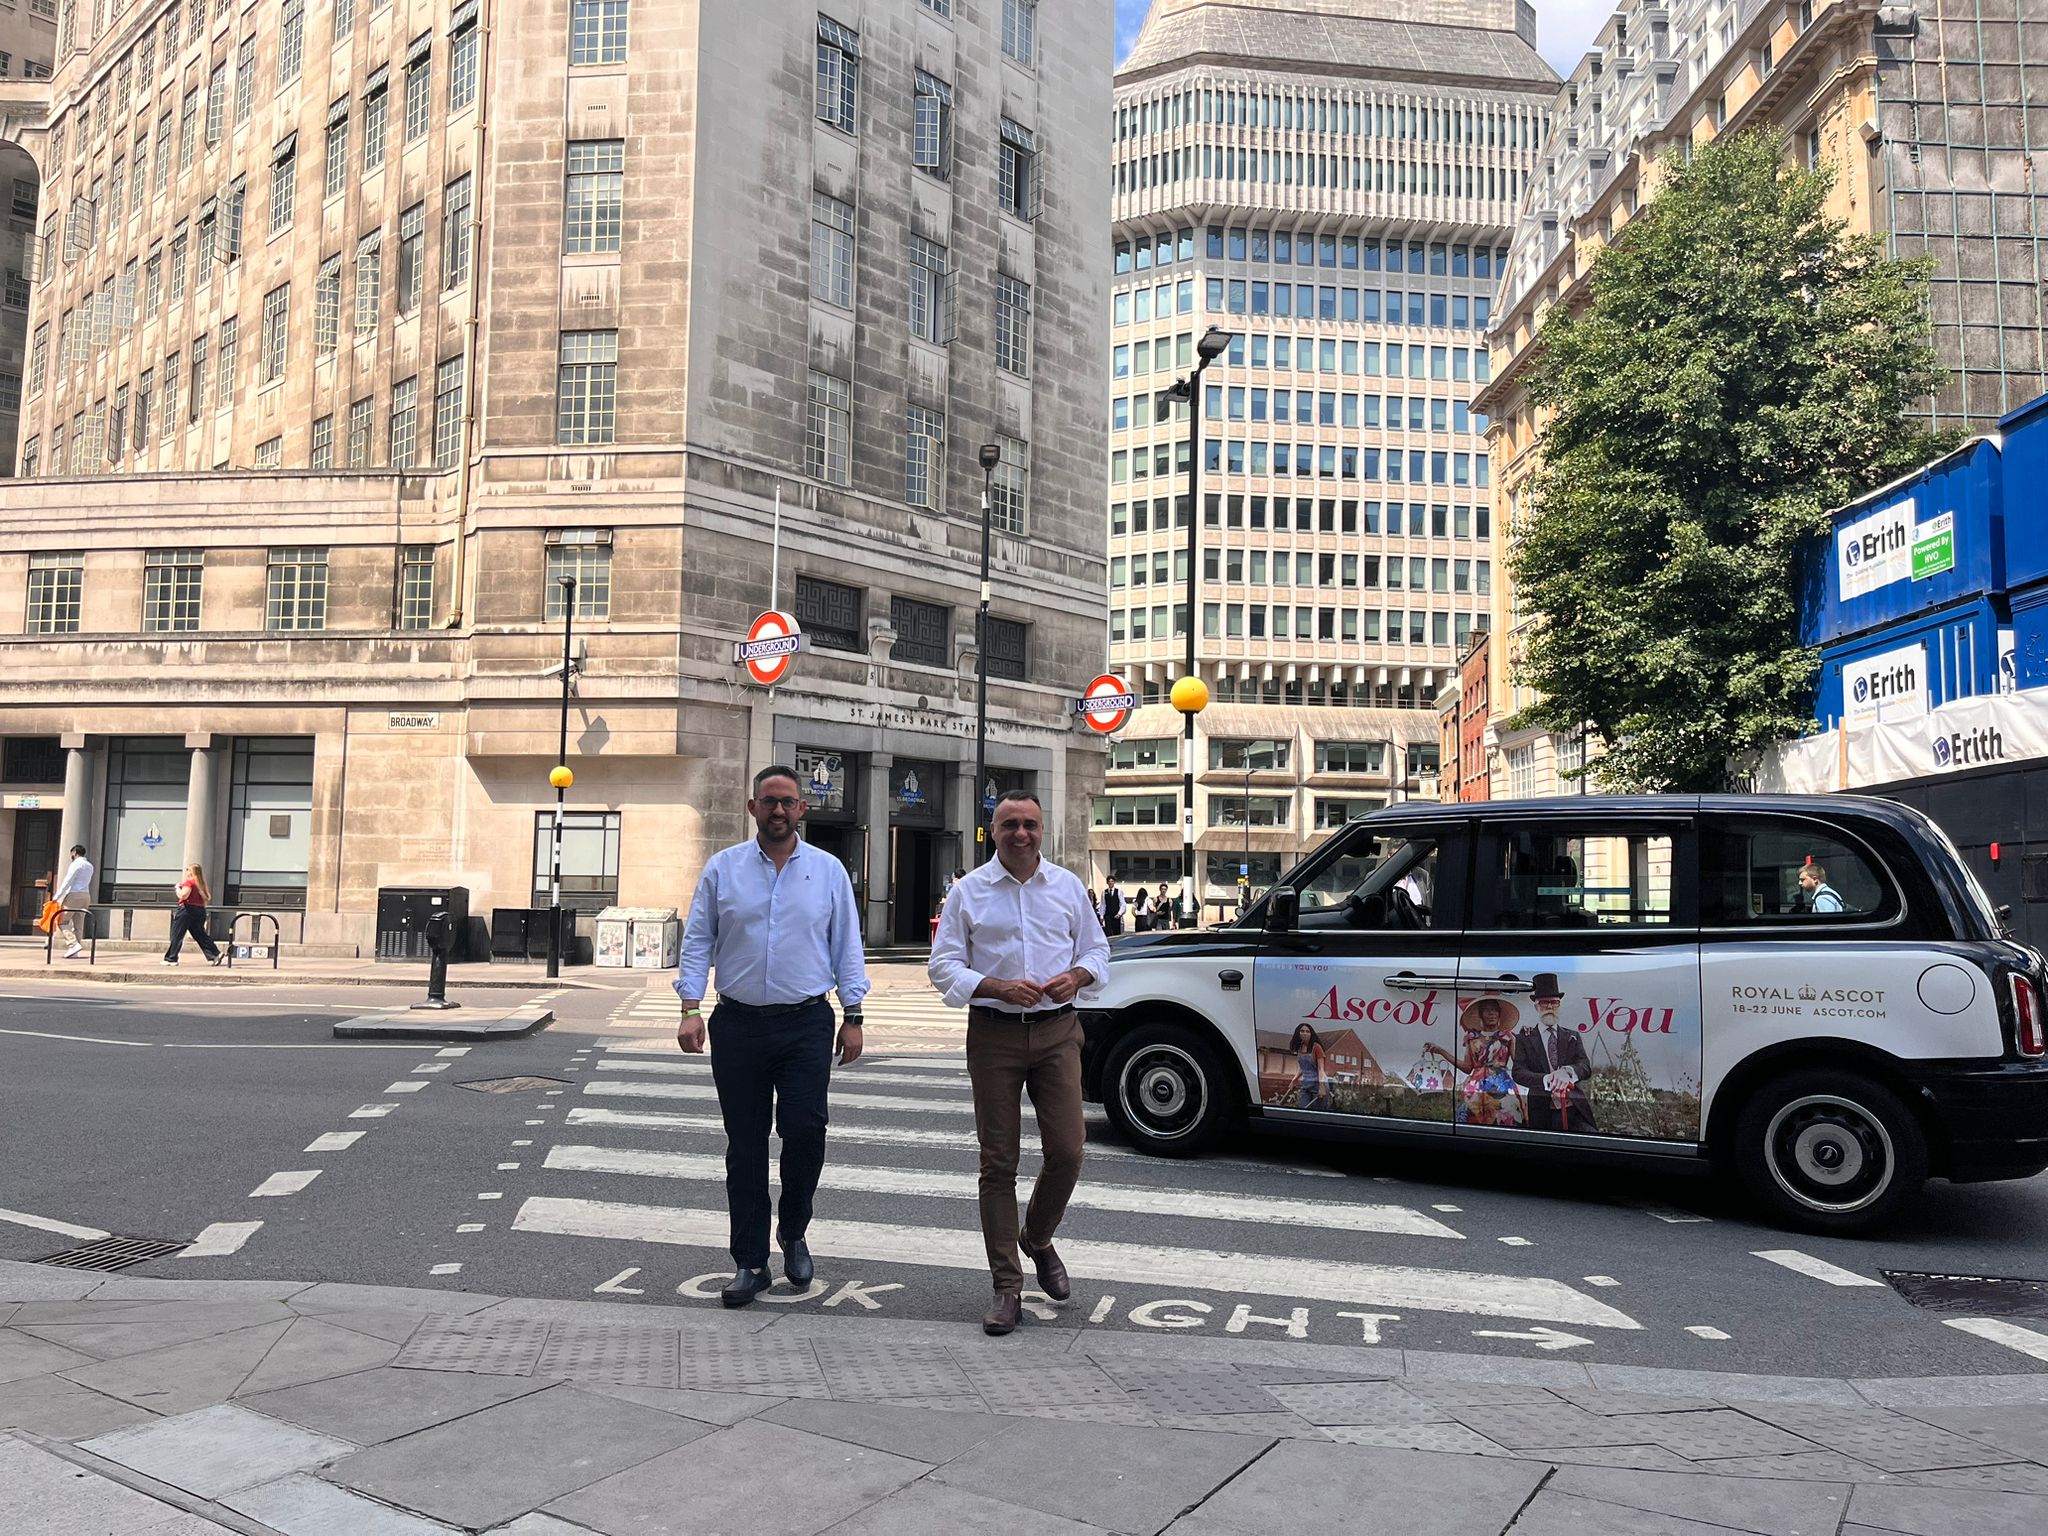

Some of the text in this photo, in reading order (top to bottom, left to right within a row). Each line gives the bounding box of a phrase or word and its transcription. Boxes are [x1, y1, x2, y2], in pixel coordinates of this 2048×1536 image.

[1937, 516, 1951, 528] Erith
[1862, 521, 1906, 562] Erith
[1914, 536, 1949, 556] Powered By
[740, 636, 798, 659] UNDERGROUND
[889, 671, 973, 696] BROADWA
[1870, 664, 1915, 700] Erith
[390, 717, 434, 727] BROADWAY
[920, 717, 946, 729] PARK
[953, 722, 995, 735] STATN
[1951, 726, 2005, 766] Erith
[239, 946, 248, 957] P
[1732, 986, 1885, 1003] ROYAL ASCOT
[1302, 985, 1440, 1026] Ascot
[1732, 1004, 1886, 1019] 18-22 JUNE ASCOT.COM
[592, 1266, 905, 1310] LOOK
